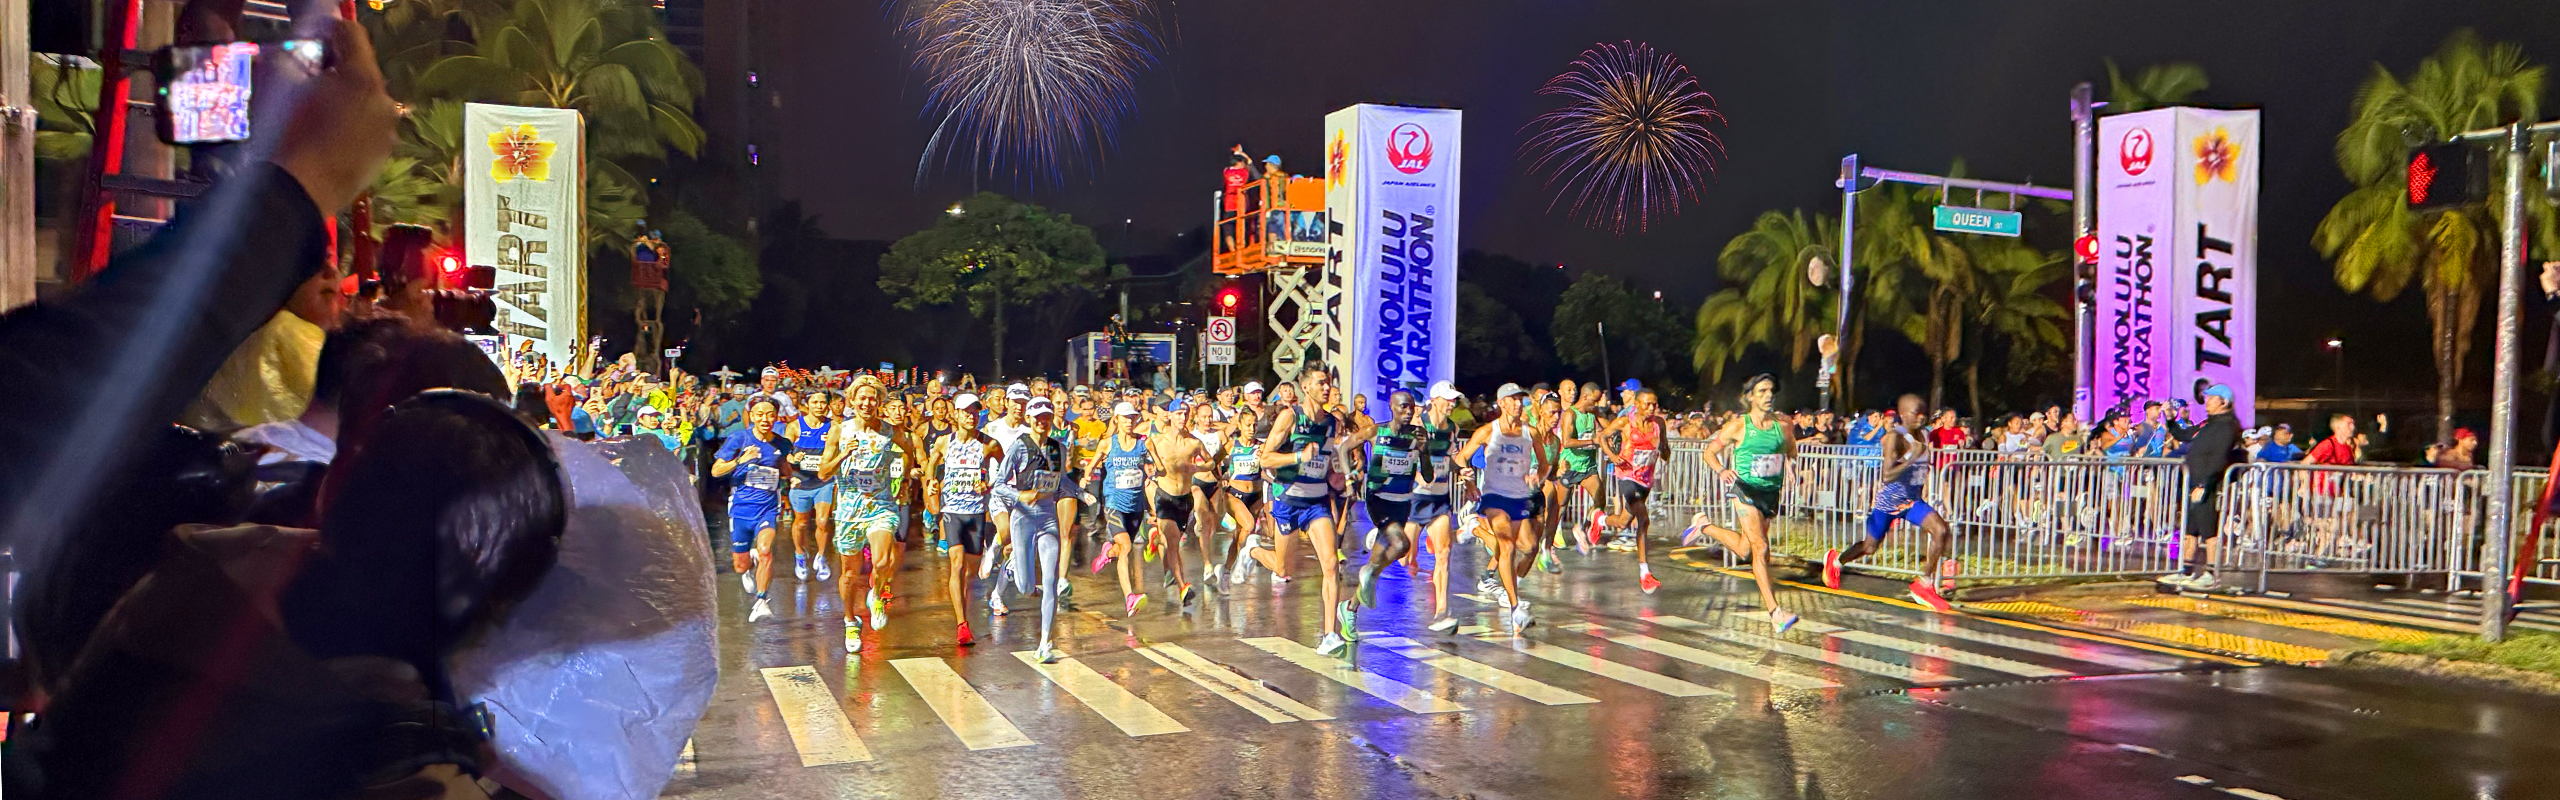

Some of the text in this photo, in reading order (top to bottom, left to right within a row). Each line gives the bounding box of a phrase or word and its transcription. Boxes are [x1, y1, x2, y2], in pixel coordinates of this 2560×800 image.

[1398, 159, 1424, 169] JAL
[1952, 212, 1991, 228] QUEEN
[496, 194, 548, 341] TART
[1377, 210, 1407, 401] HONOLULU
[1212, 347, 1231, 355] NO U
